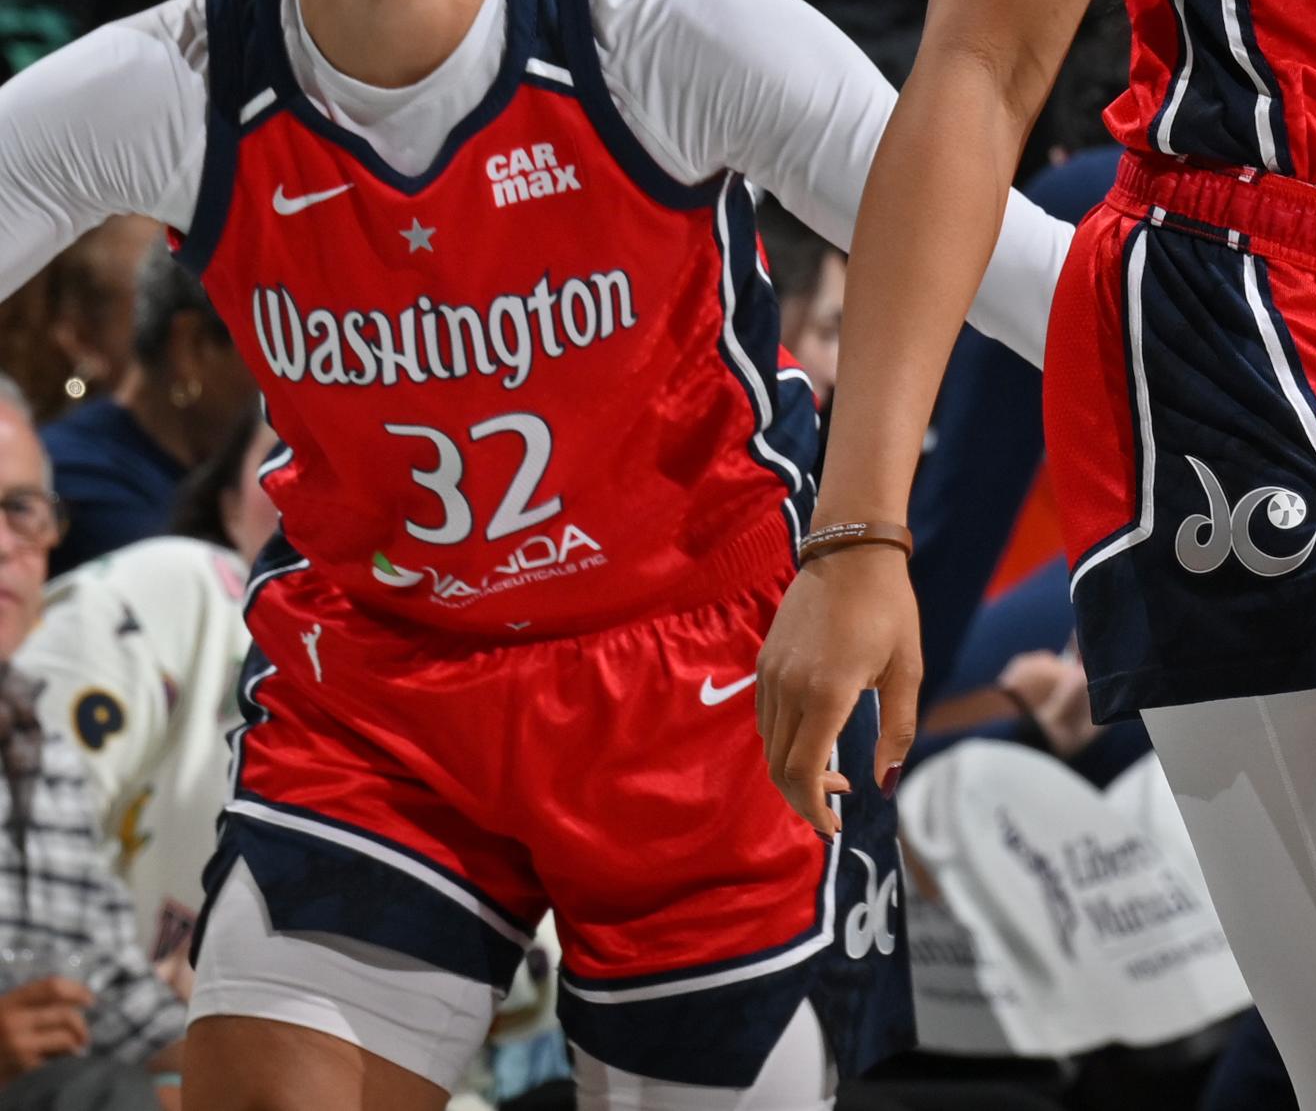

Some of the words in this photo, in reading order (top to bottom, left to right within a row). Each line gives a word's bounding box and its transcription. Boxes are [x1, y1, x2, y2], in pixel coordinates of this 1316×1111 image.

[486, 142, 558, 182] CAR
[491, 164, 582, 208] max
[383, 411, 564, 546] 32
